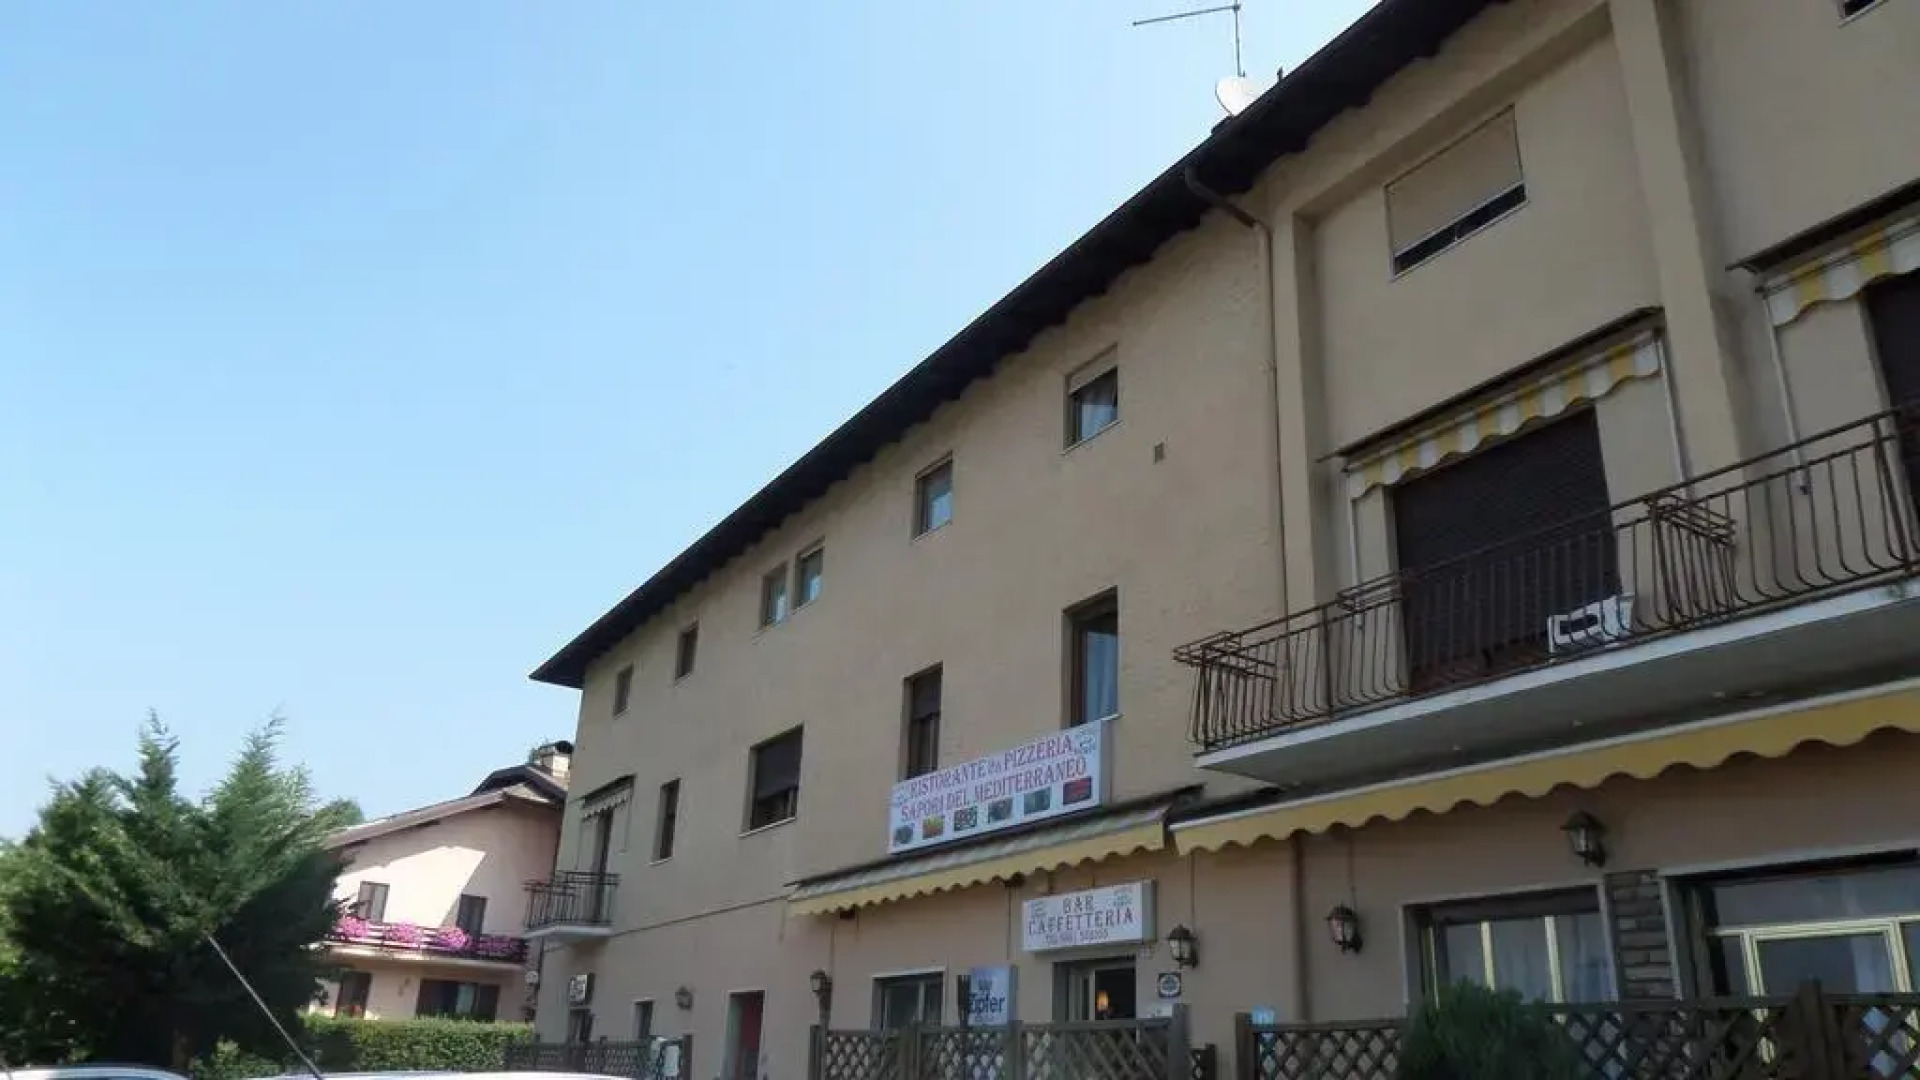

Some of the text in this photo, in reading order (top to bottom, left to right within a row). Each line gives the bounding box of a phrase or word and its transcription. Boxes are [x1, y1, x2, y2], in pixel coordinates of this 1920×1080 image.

[901, 794, 944, 822] SAPORI
[946, 788, 969, 811] DEL
[974, 757, 1087, 801] MEDITERRANEO
[910, 758, 988, 798] RISTORANTE
[1004, 735, 1073, 771] PIZZERIA
[1028, 906, 1134, 936] CAFFETTERIA
[1062, 895, 1094, 914] BAR
